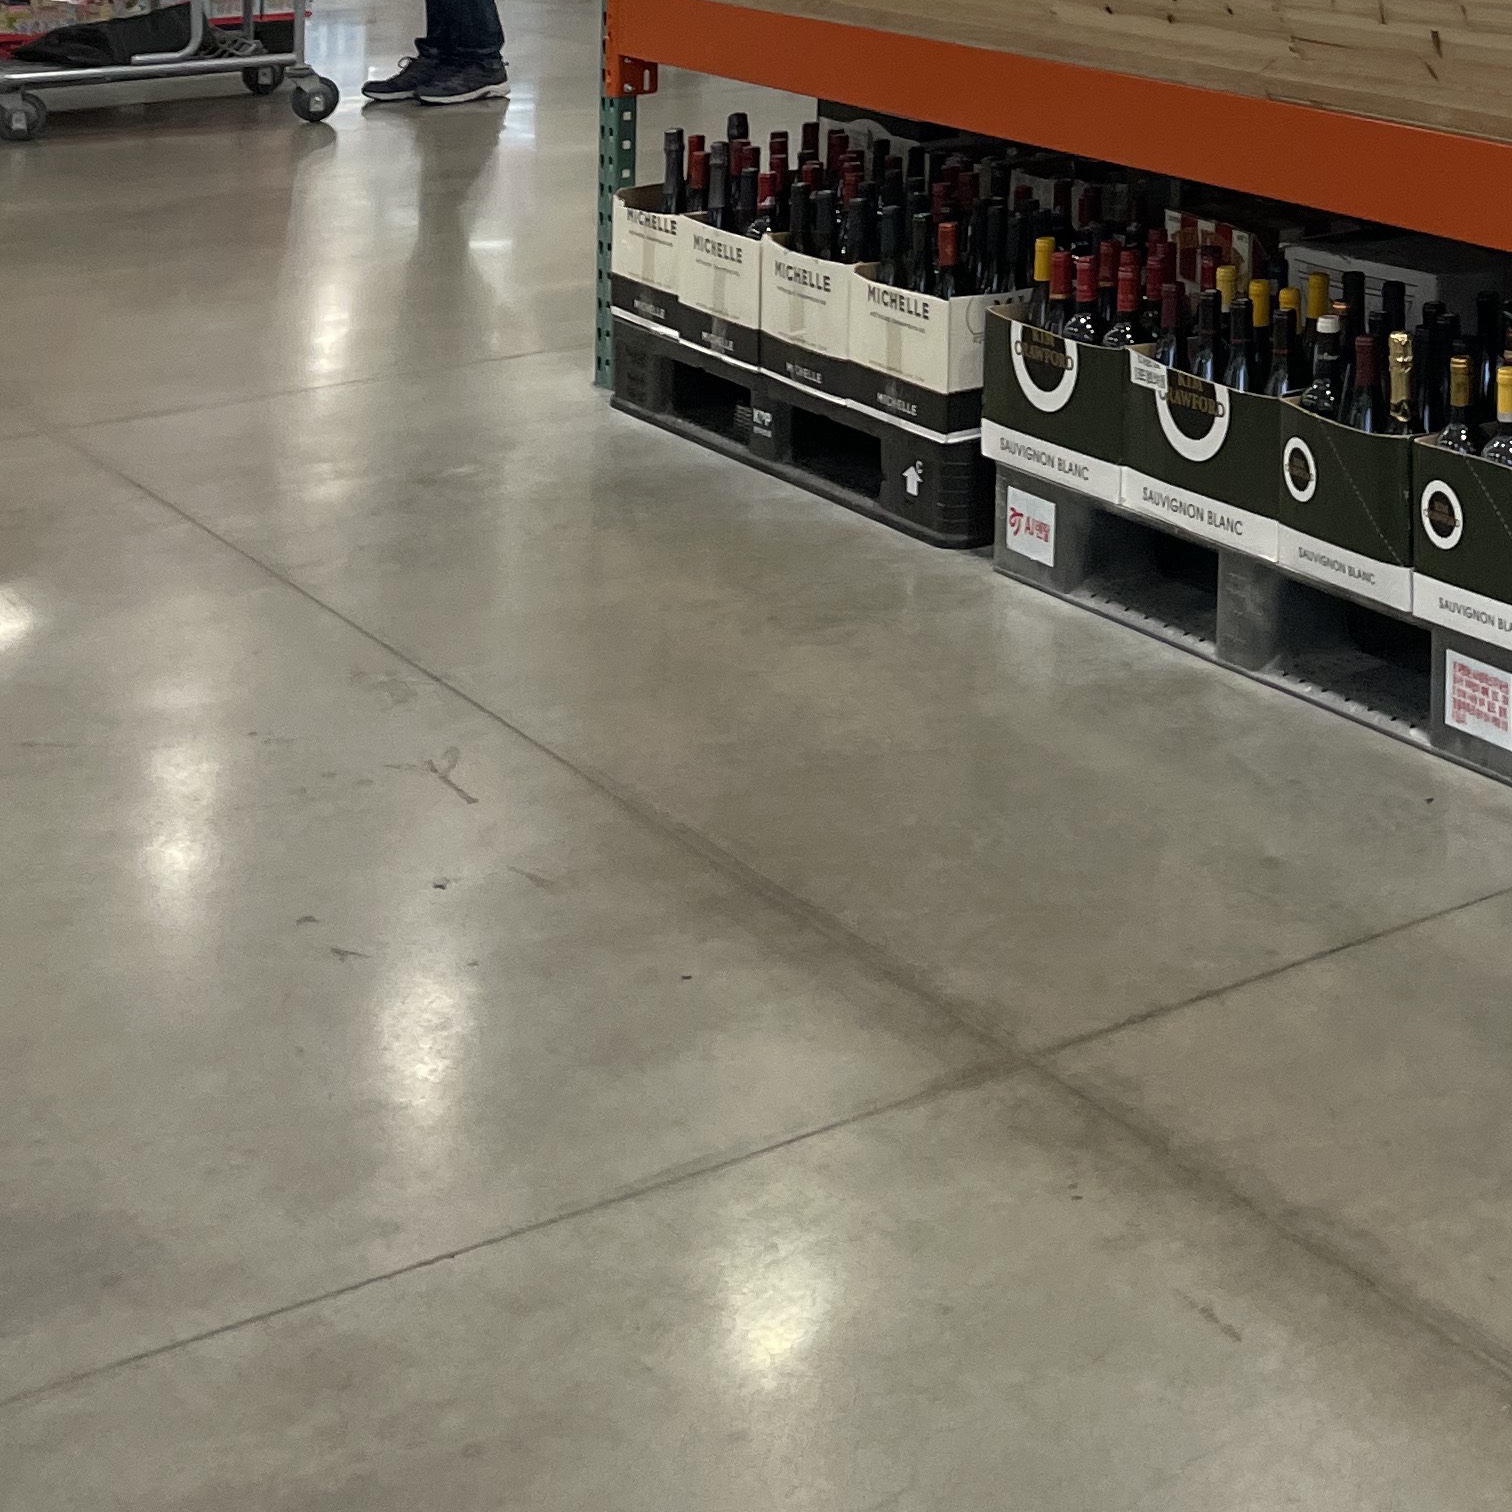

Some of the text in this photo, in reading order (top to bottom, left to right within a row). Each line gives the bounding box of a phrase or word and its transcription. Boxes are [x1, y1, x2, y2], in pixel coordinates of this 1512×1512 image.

[627, 208, 677, 235] MICHELLE
[693, 234, 743, 264] MICHELLE
[774, 260, 832, 293] MICHELLE
[867, 284, 930, 320] MICHELLE
[1000, 437, 1090, 481] SAUVIGNON BLANC
[1142, 486, 1244, 536] SAUVIGNON BLANC
[1298, 546, 1376, 585] SAUVIGNON BLANC
[1438, 597, 1494, 627] SAUVIGNON
